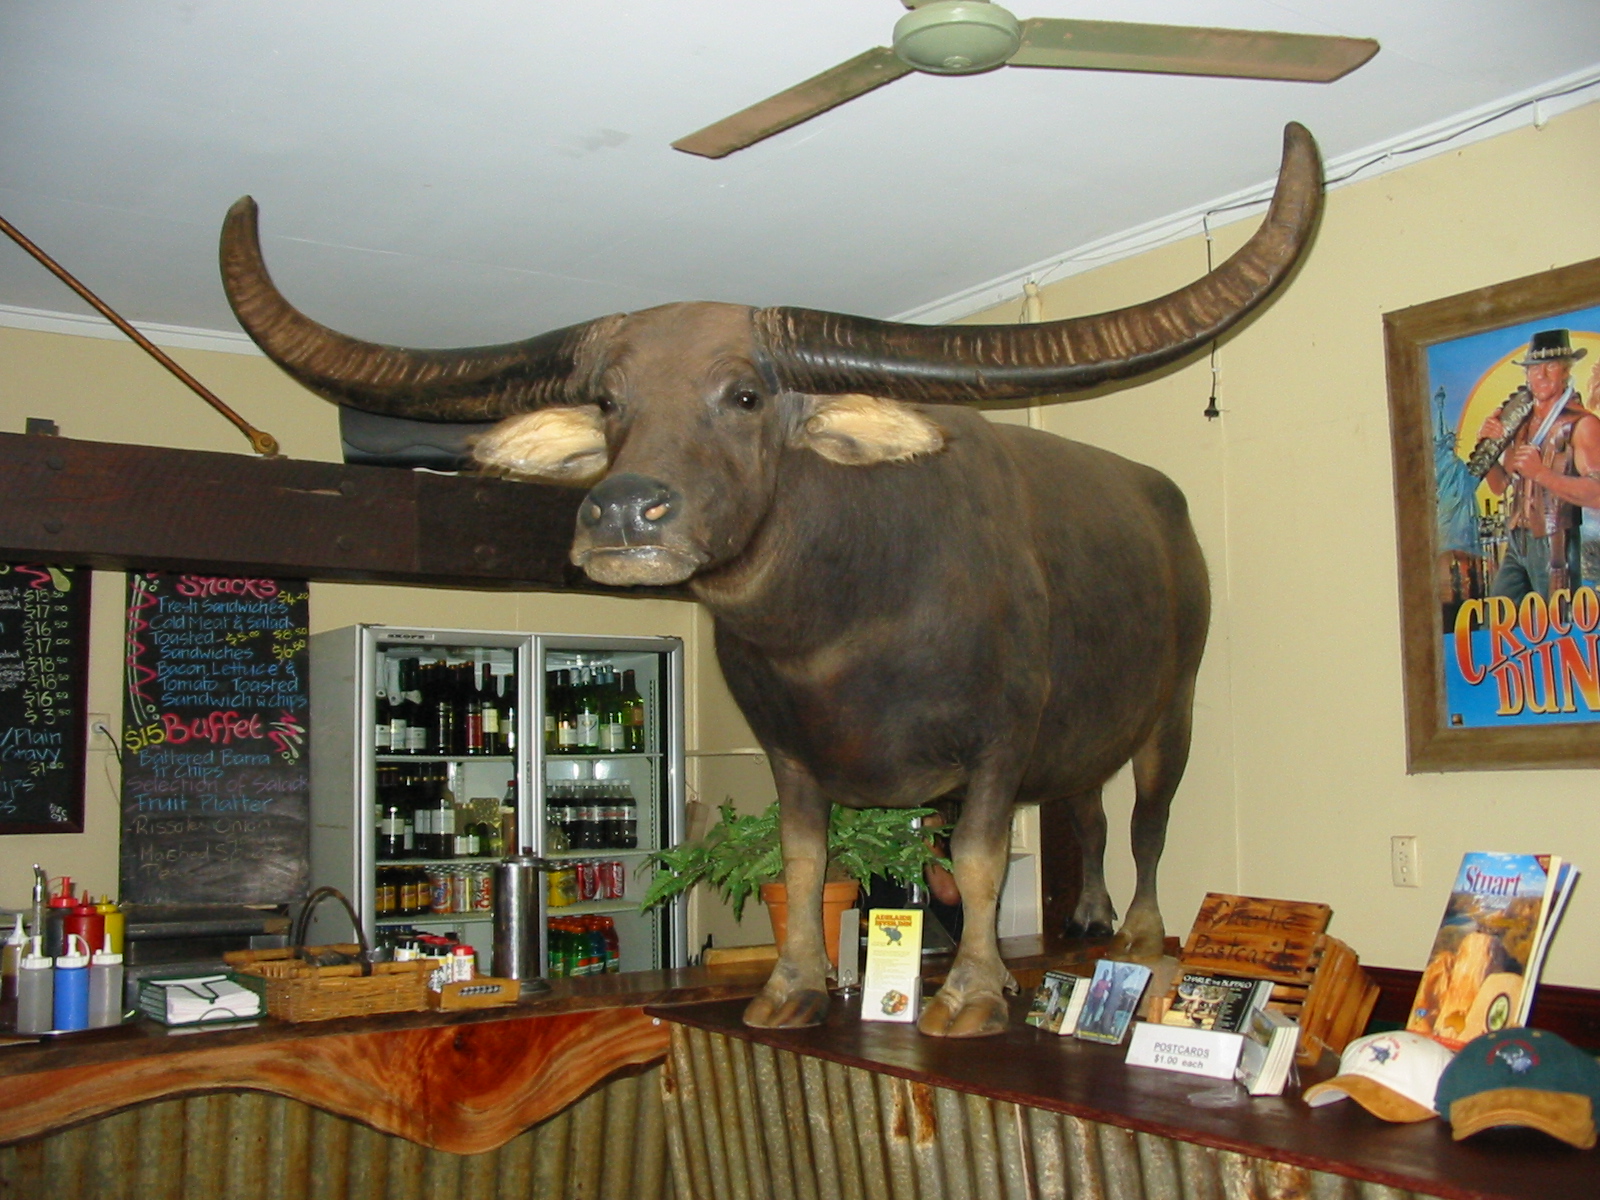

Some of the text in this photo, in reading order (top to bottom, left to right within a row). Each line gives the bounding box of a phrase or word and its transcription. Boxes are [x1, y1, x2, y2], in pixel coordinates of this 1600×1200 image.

[157, 595, 197, 614] Fresh
[202, 598, 289, 614] Sandwiches
[150, 613, 185, 630] Cold
[189, 615, 229, 630] Meat
[232, 614, 244, 632] &
[150, 630, 215, 645] Toasted
[1454, 586, 1600, 684] CROCO
[160, 644, 254, 660] Sandwiches
[212, 661, 277, 676] Lettuce
[285, 660, 296, 676] &
[158, 676, 299, 693] Tomato Toasted
[161, 692, 250, 708] Sandwich
[125, 710, 263, 754] $15 Buffet
[139, 748, 270, 767] Battered Barra
[127, 776, 218, 793] Selection
[227, 774, 246, 794] of
[134, 793, 273, 812] Fruit Platter
[1462, 865, 1522, 897] Stuart
[1153, 1042, 1210, 1059] POSTCARDS
[1153, 1054, 1204, 1069] $1.00 each
